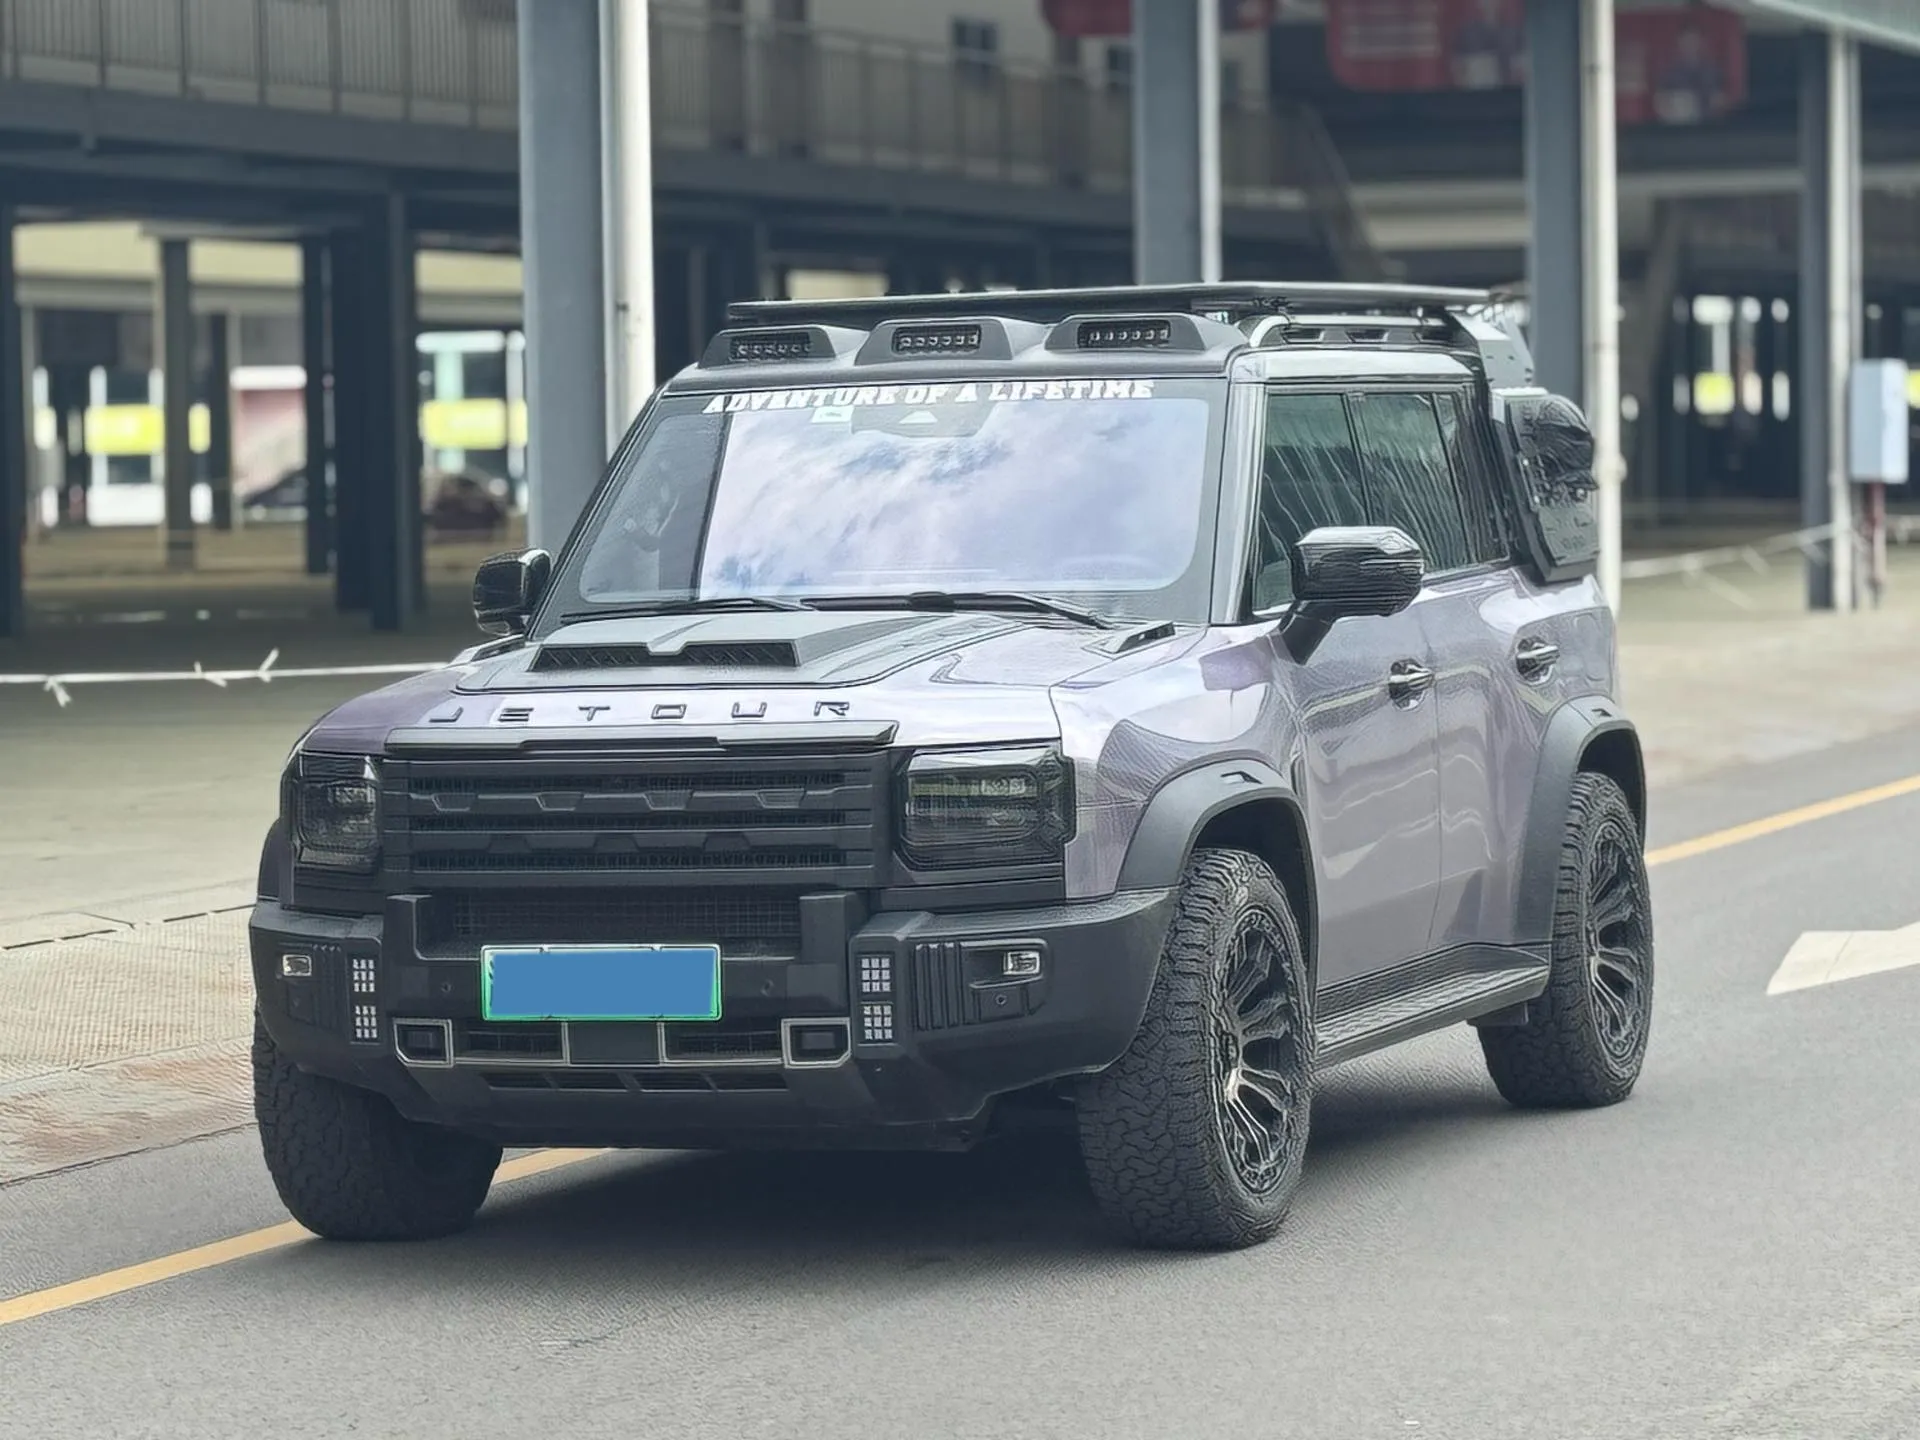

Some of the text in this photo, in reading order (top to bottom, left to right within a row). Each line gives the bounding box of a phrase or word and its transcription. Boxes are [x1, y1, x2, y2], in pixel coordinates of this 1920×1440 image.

[703, 380, 1155, 413] ADVENTURE OF A LIFETIME
[429, 701, 850, 722] JETOUR
